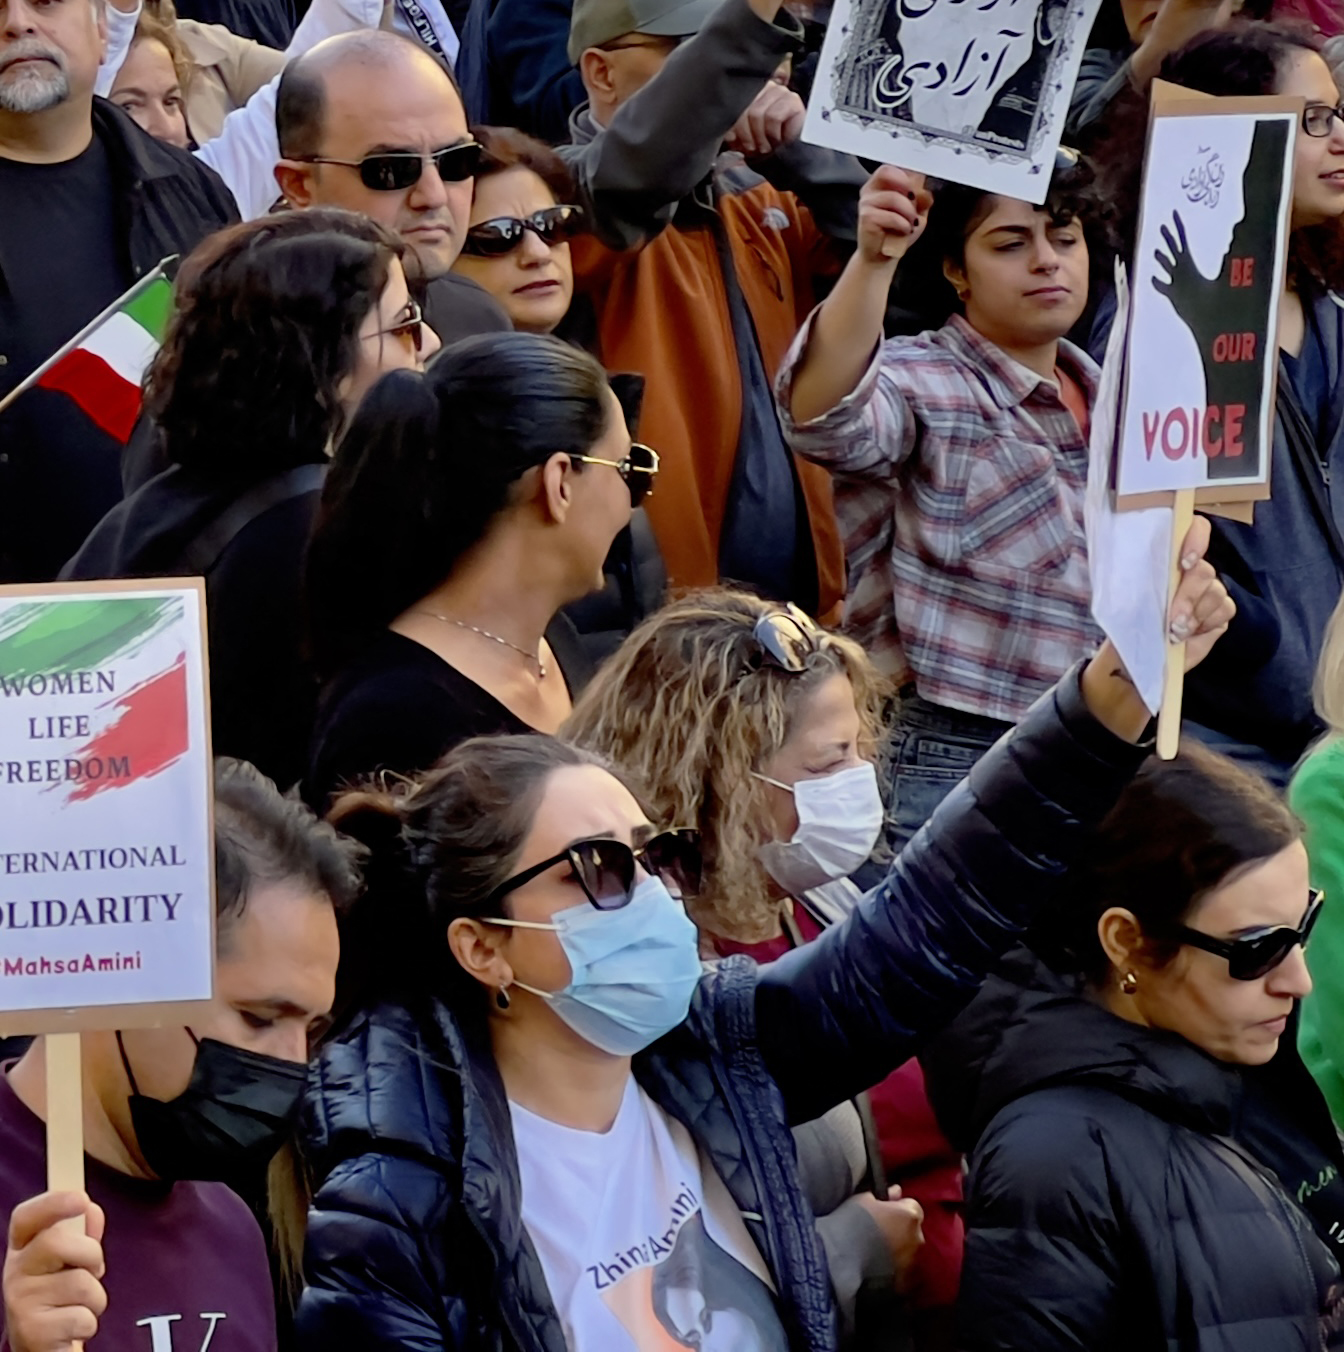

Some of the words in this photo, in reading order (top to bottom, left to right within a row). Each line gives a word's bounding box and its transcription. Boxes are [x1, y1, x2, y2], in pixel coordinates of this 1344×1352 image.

[872, 29, 1025, 109] آزادی
[1229, 257, 1256, 288] BE
[1212, 332, 1256, 363] OUR
[1142, 403, 1247, 463] VOICE
[0, 670, 117, 698] WOMEN
[28, 715, 91, 740] LIFE
